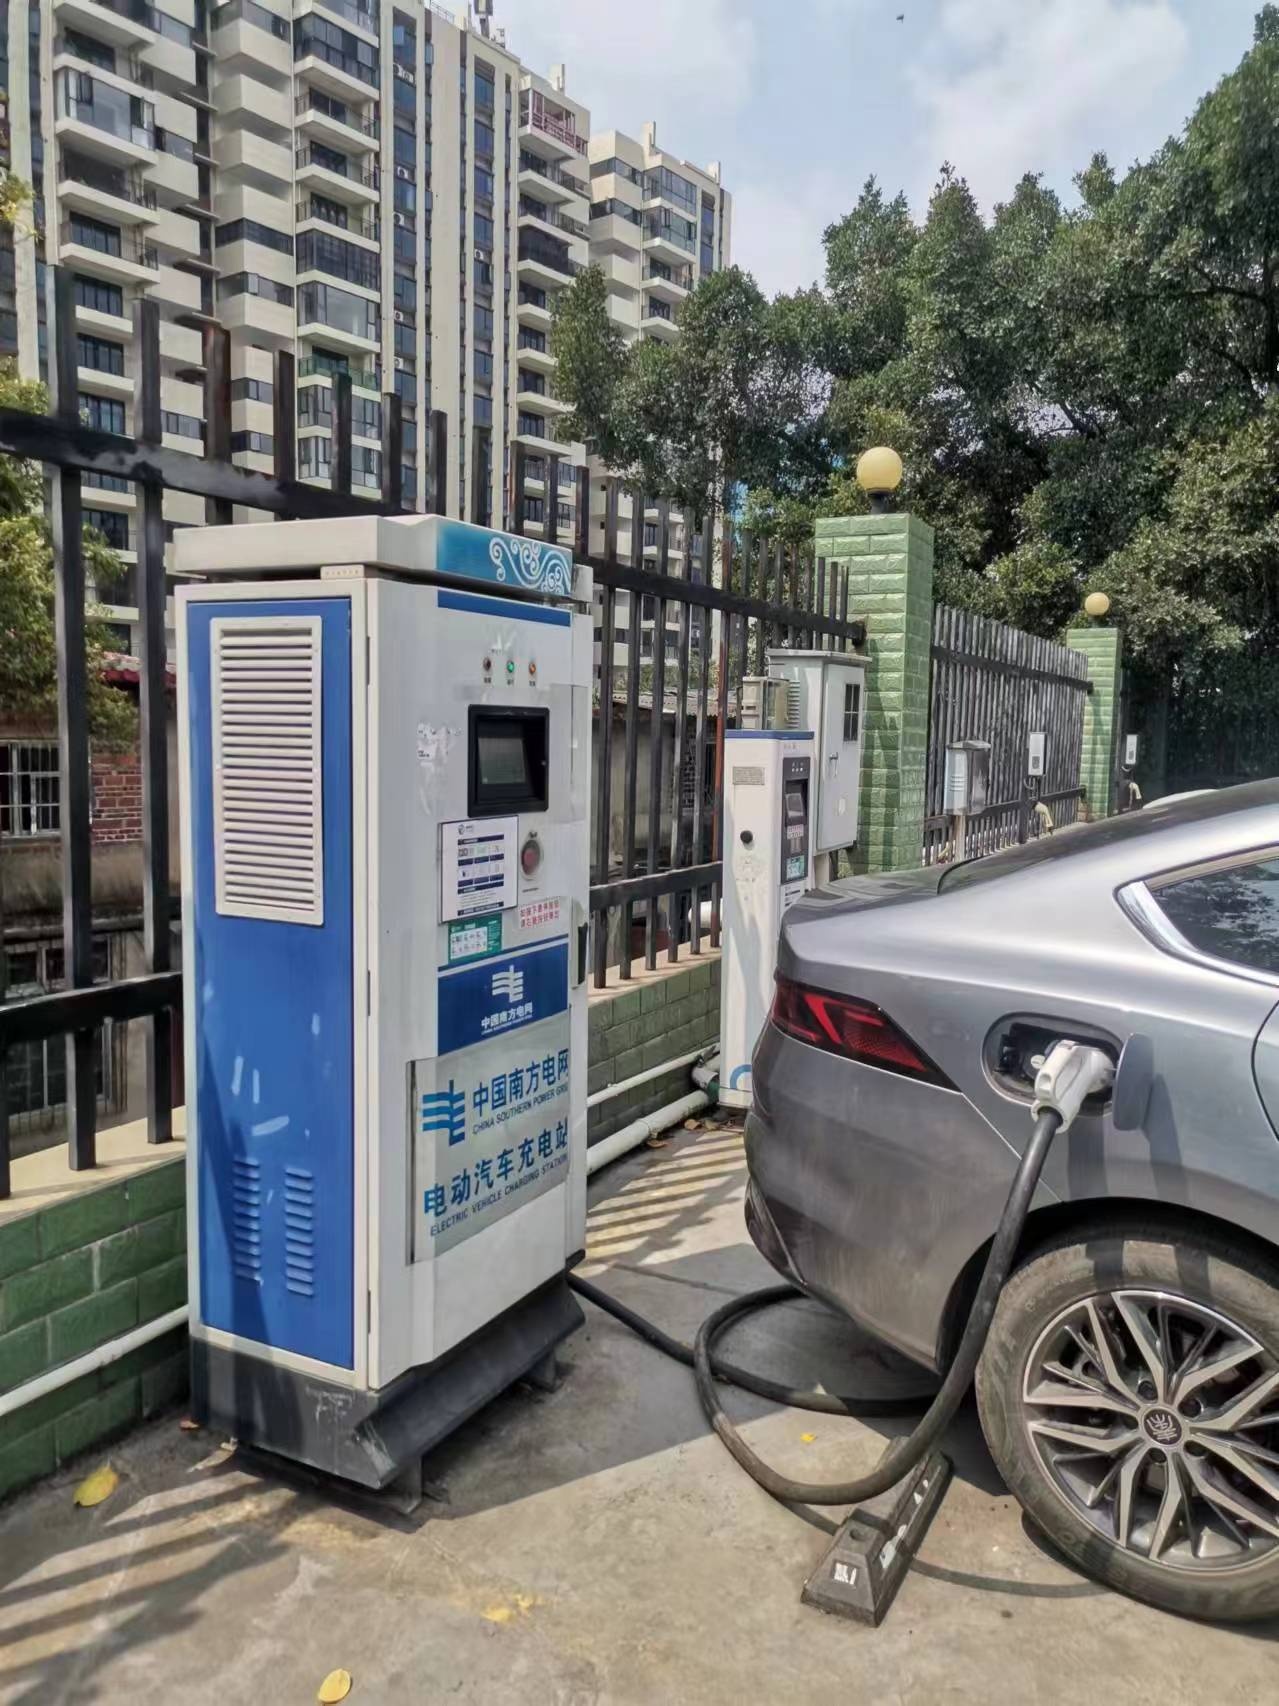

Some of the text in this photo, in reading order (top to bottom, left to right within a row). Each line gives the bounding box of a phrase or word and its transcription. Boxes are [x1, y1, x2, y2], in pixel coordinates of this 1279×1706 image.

[481, 1001, 533, 1029] 中国南方电网
[473, 1048, 568, 1117] 中国南方电网
[473, 1117, 495, 1134] CHINA
[496, 1101, 532, 1124] SOUTHERN
[533, 1090, 556, 1106] POWER
[424, 1116, 568, 1217] 电动汽车充电站
[430, 1207, 469, 1236] ELECTRIC
[471, 1189, 502, 1213] VEHICLE
[504, 1169, 540, 1195] CHARGING
